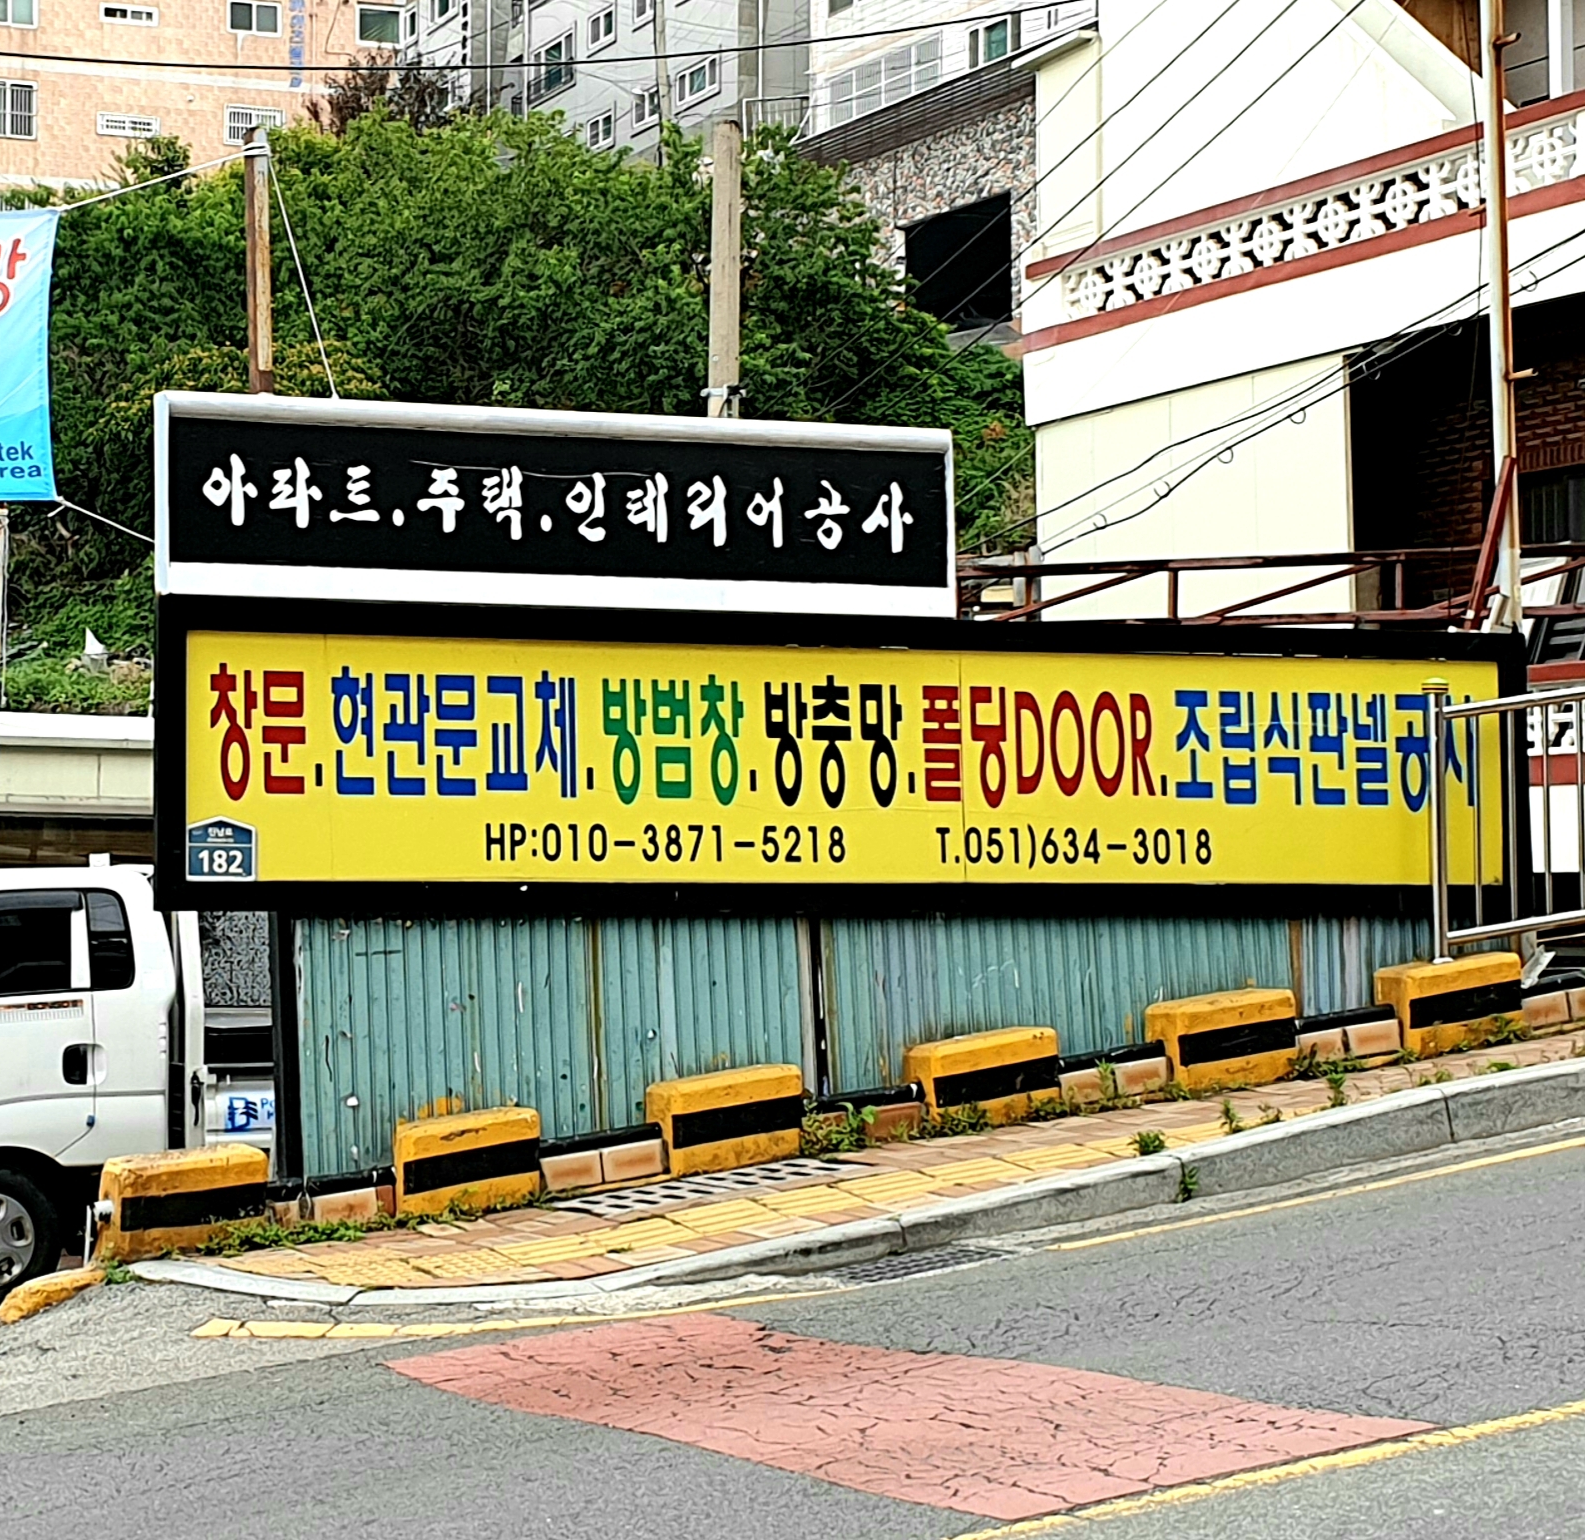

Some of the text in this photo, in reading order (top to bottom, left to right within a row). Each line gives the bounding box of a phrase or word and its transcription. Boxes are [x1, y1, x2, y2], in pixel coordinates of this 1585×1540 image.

[198, 849, 243, 873] 182
[485, 822, 1213, 869] HP:010-3871-5218 T.051)634-3018
